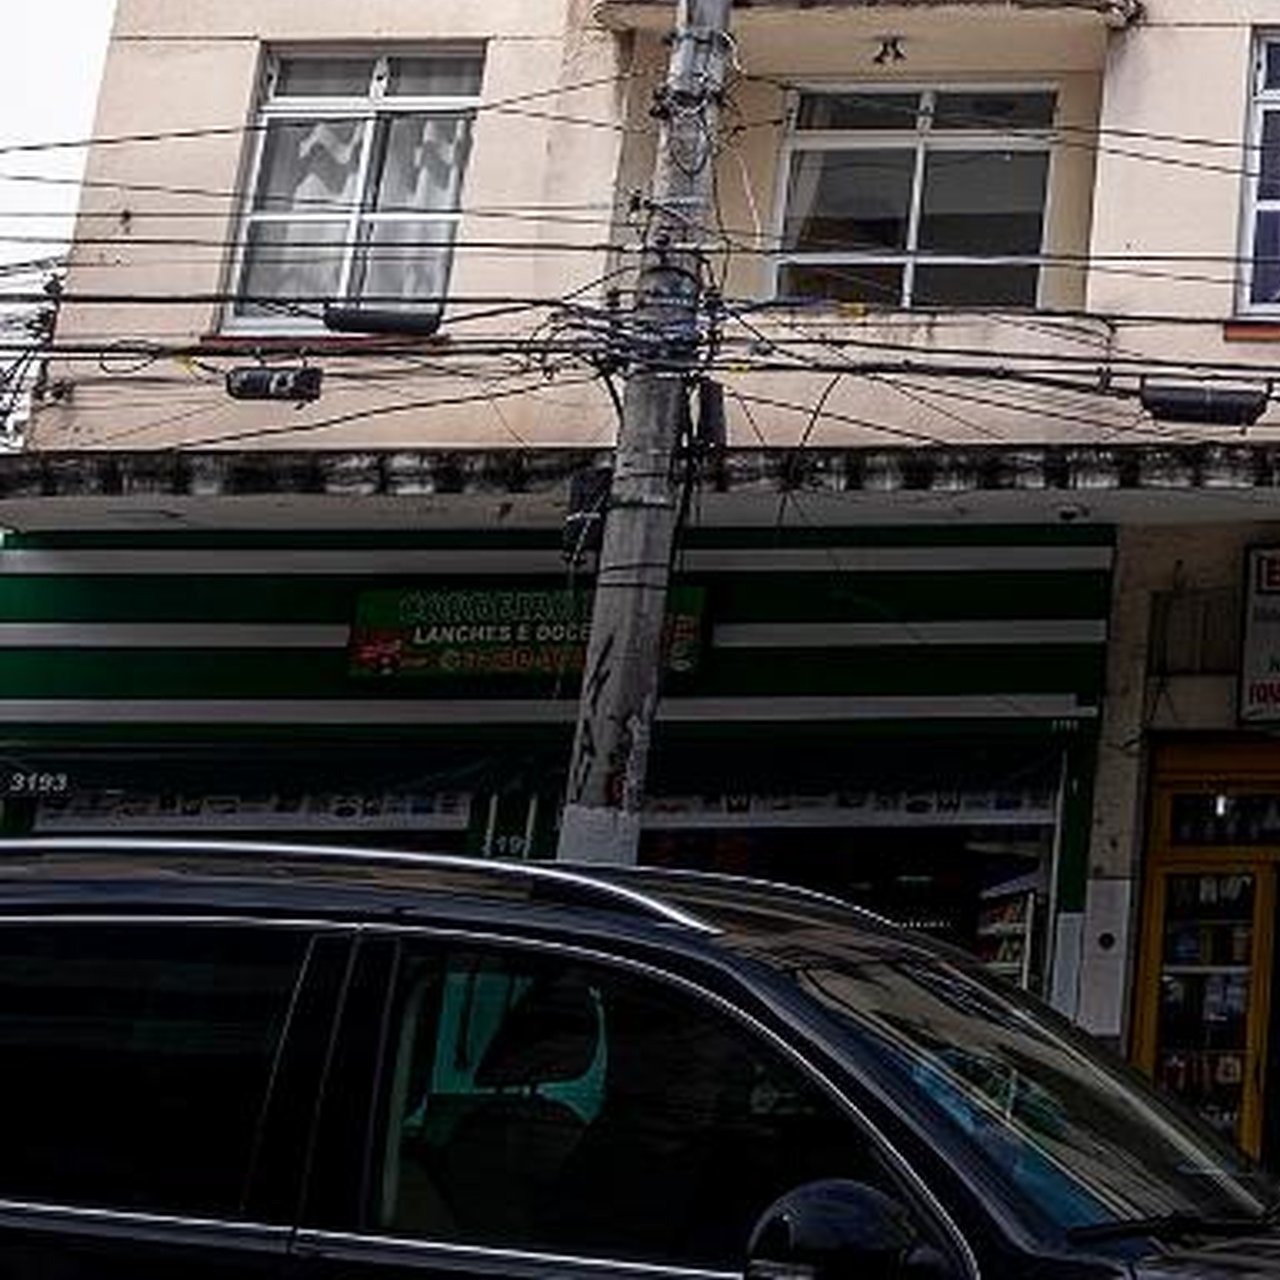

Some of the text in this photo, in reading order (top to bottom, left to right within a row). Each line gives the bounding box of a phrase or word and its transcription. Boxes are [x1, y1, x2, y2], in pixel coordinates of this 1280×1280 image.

[411, 624, 592, 643] LANCHES E DOCE
